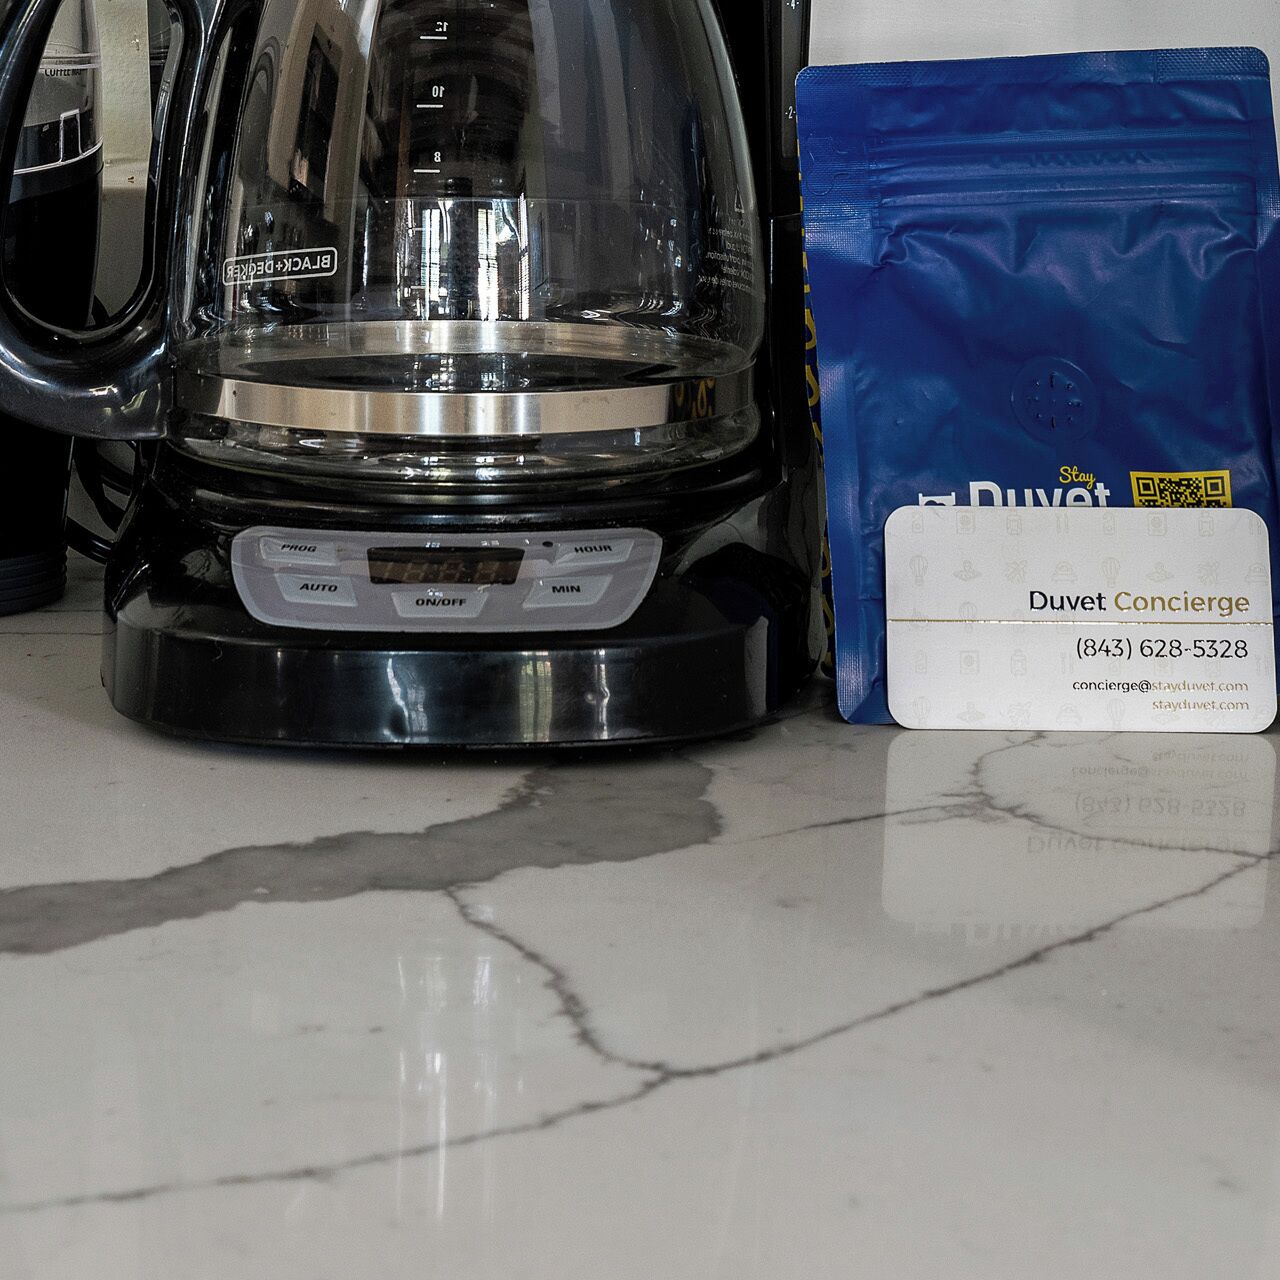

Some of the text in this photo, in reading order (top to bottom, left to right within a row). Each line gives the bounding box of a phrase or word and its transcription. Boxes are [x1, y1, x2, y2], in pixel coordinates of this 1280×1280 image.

[1059, 466, 1096, 490] Stay
[280, 543, 318, 553] PROG
[574, 544, 613, 553] HOUR
[299, 583, 338, 593] AUTO
[551, 584, 581, 593] MIN
[415, 598, 467, 607] ON/OFF
[1029, 590, 1251, 618] Duvet Concierge
[1076, 637, 1249, 660] (843) 628-5328
[1072, 679, 1250, 693] concierge@stayduvet.com
[1152, 699, 1250, 711] stayduvet.com
